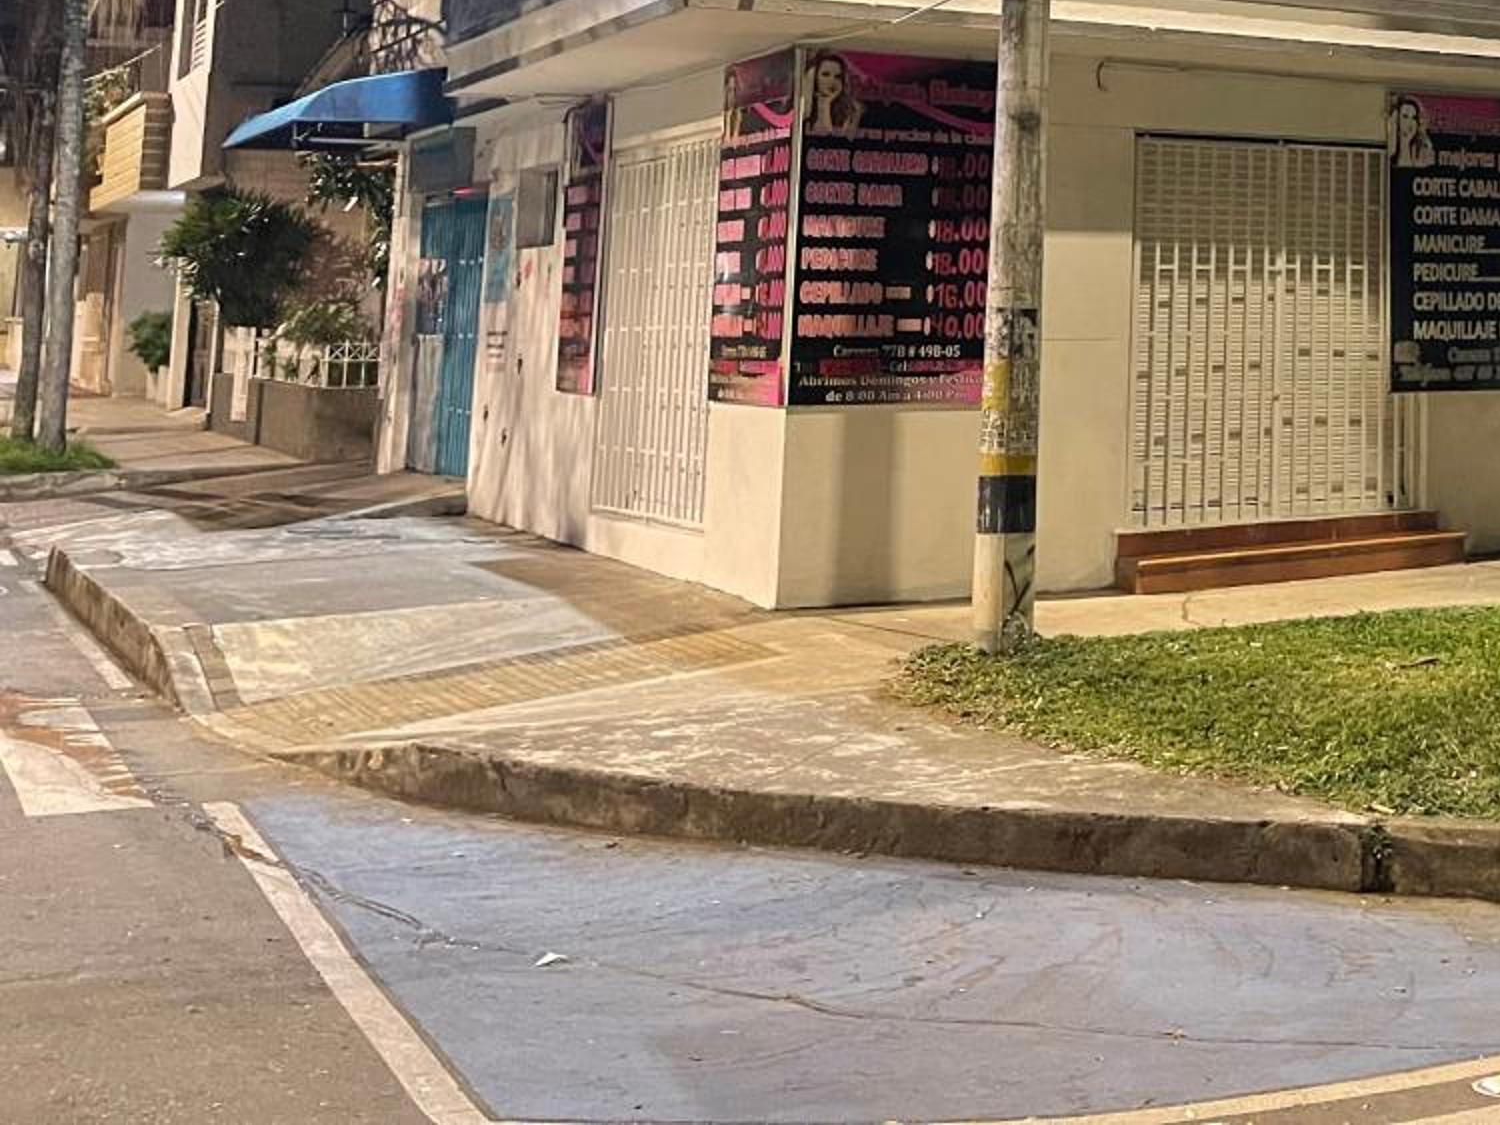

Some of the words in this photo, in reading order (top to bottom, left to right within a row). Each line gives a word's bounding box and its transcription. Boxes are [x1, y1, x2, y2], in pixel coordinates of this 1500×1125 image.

[1412, 177, 1457, 198] CORTE
[1412, 205, 1457, 225] CORTE
[1412, 235, 1487, 254] MANICURE
[1412, 262, 1480, 283] PEDICURE
[1412, 291, 1485, 312] CEPILLADO
[1412, 319, 1498, 342] MAQUILLAJE
